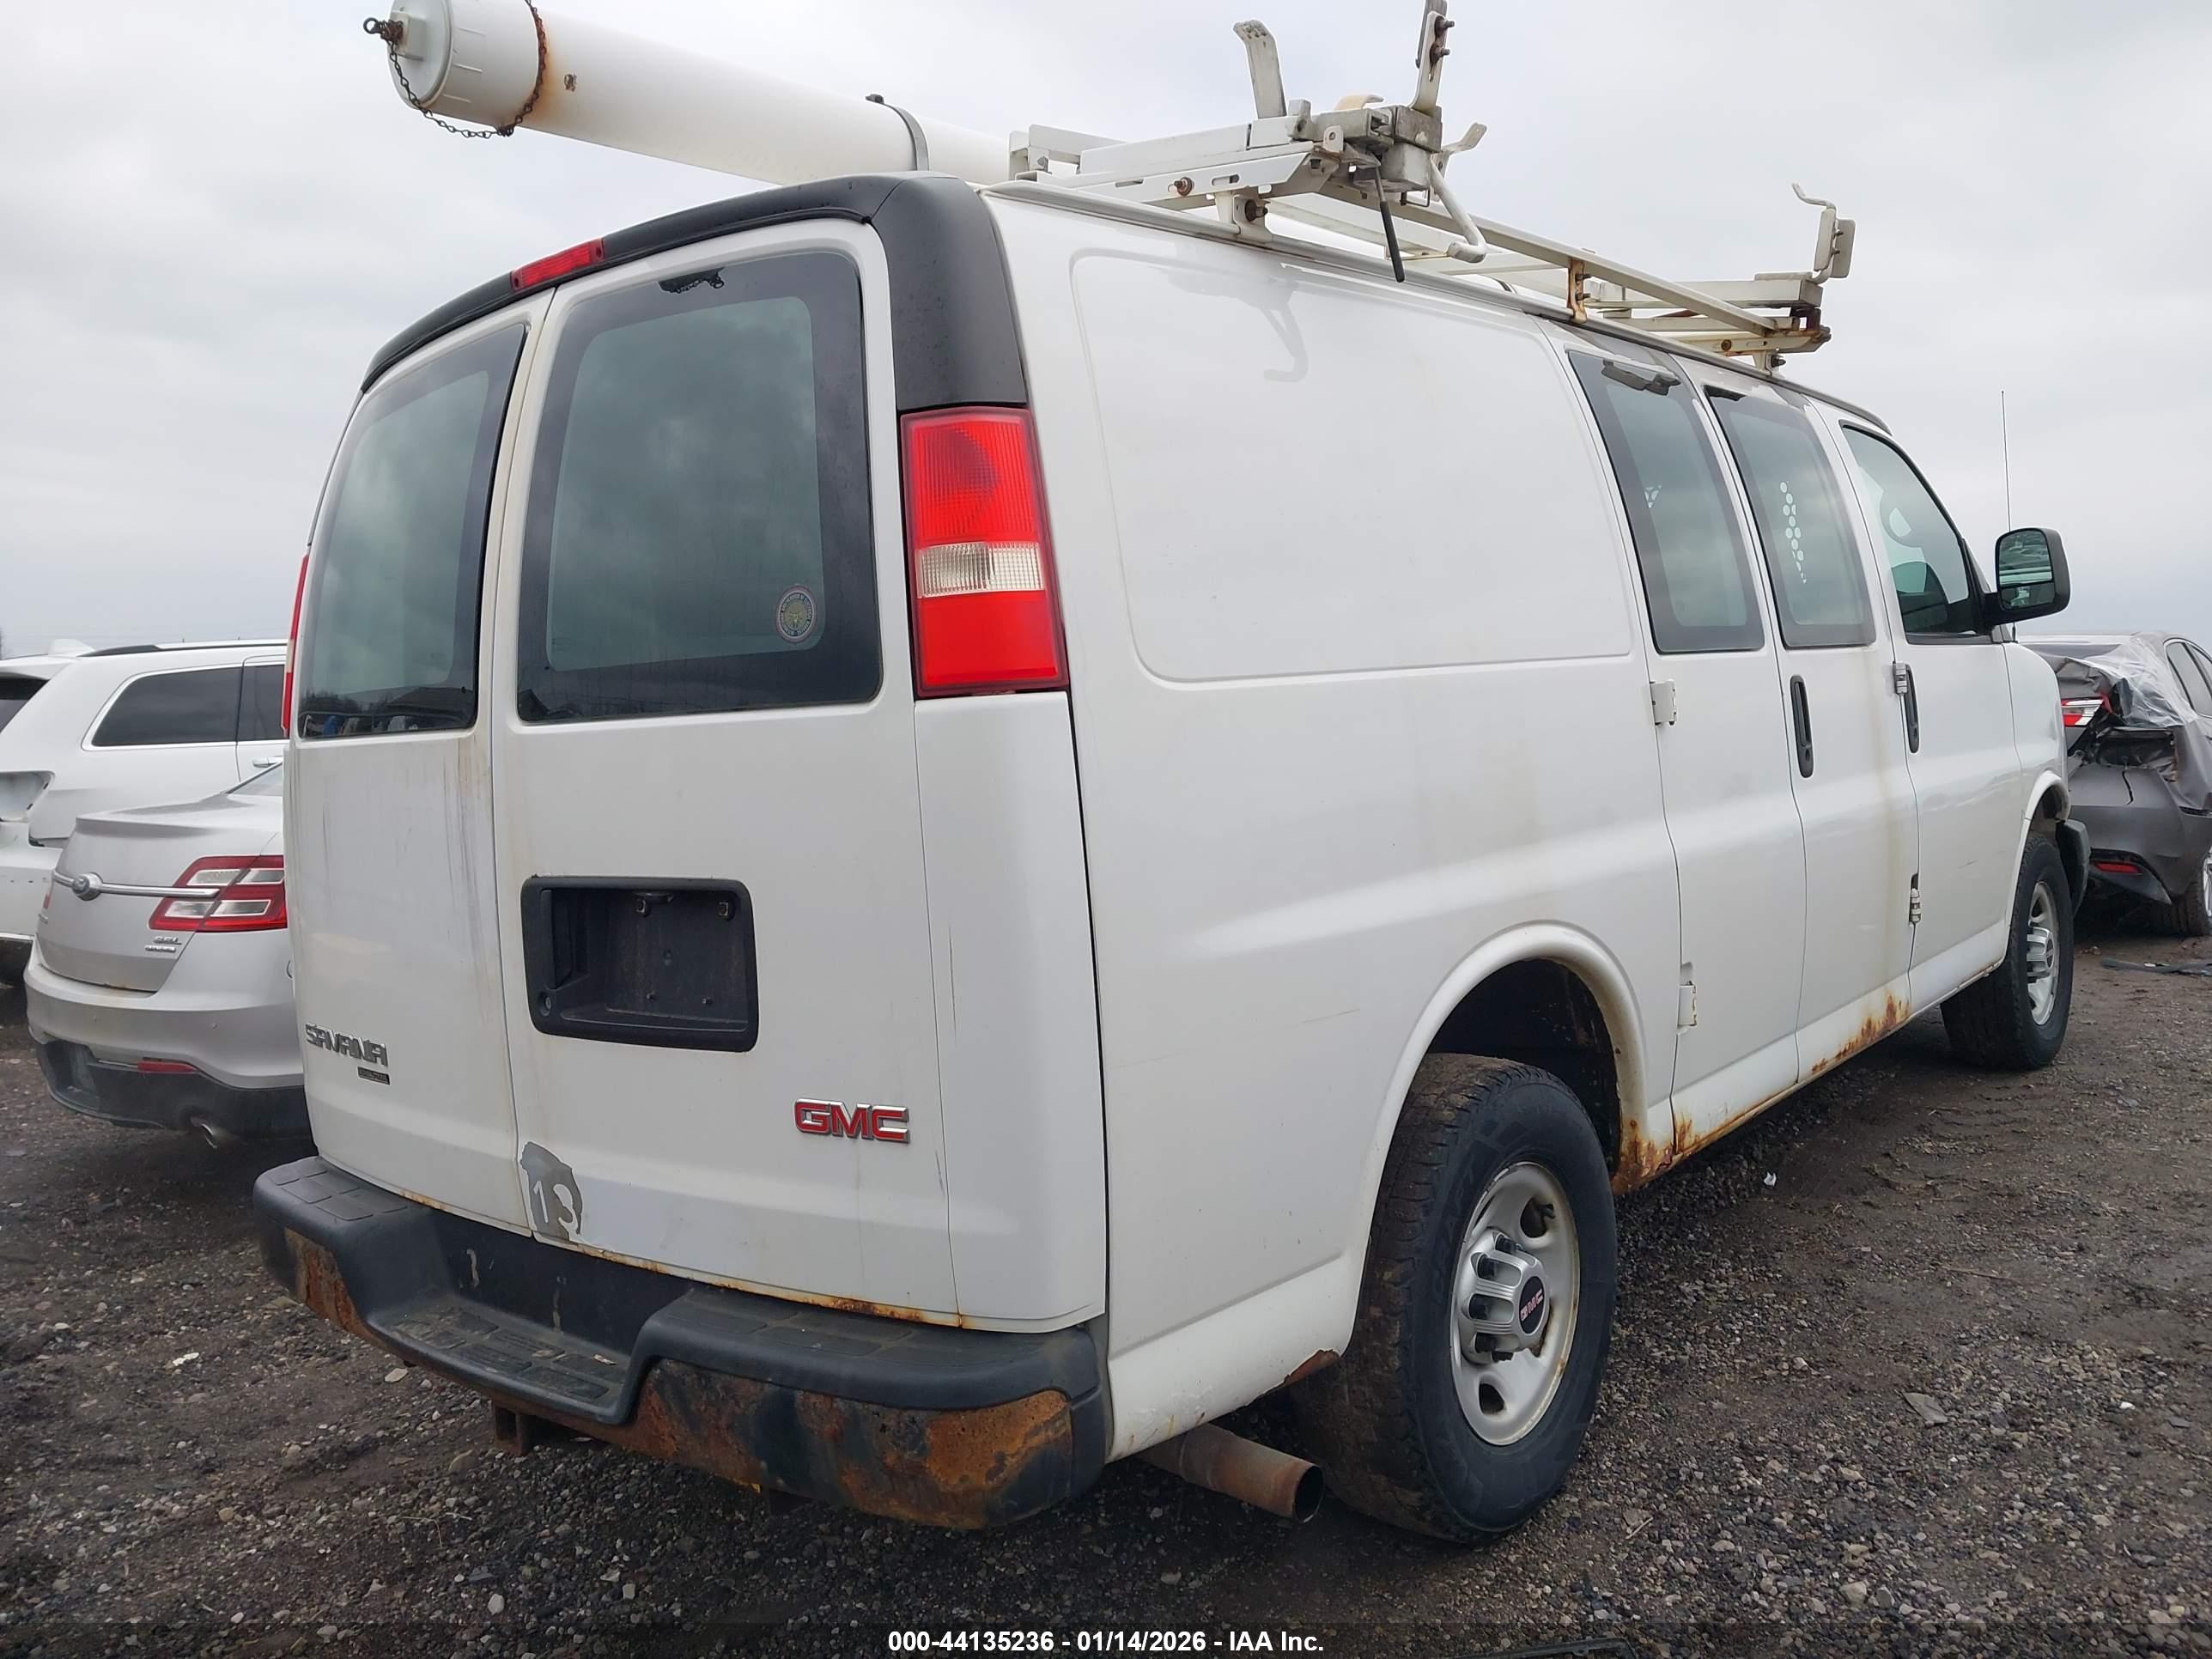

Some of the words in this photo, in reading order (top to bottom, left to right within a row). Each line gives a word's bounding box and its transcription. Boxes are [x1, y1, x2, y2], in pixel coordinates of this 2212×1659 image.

[305, 1022, 389, 1066] SAVANA
[794, 1097, 910, 1144] GMC
[1520, 1288, 1544, 1322] GMC
